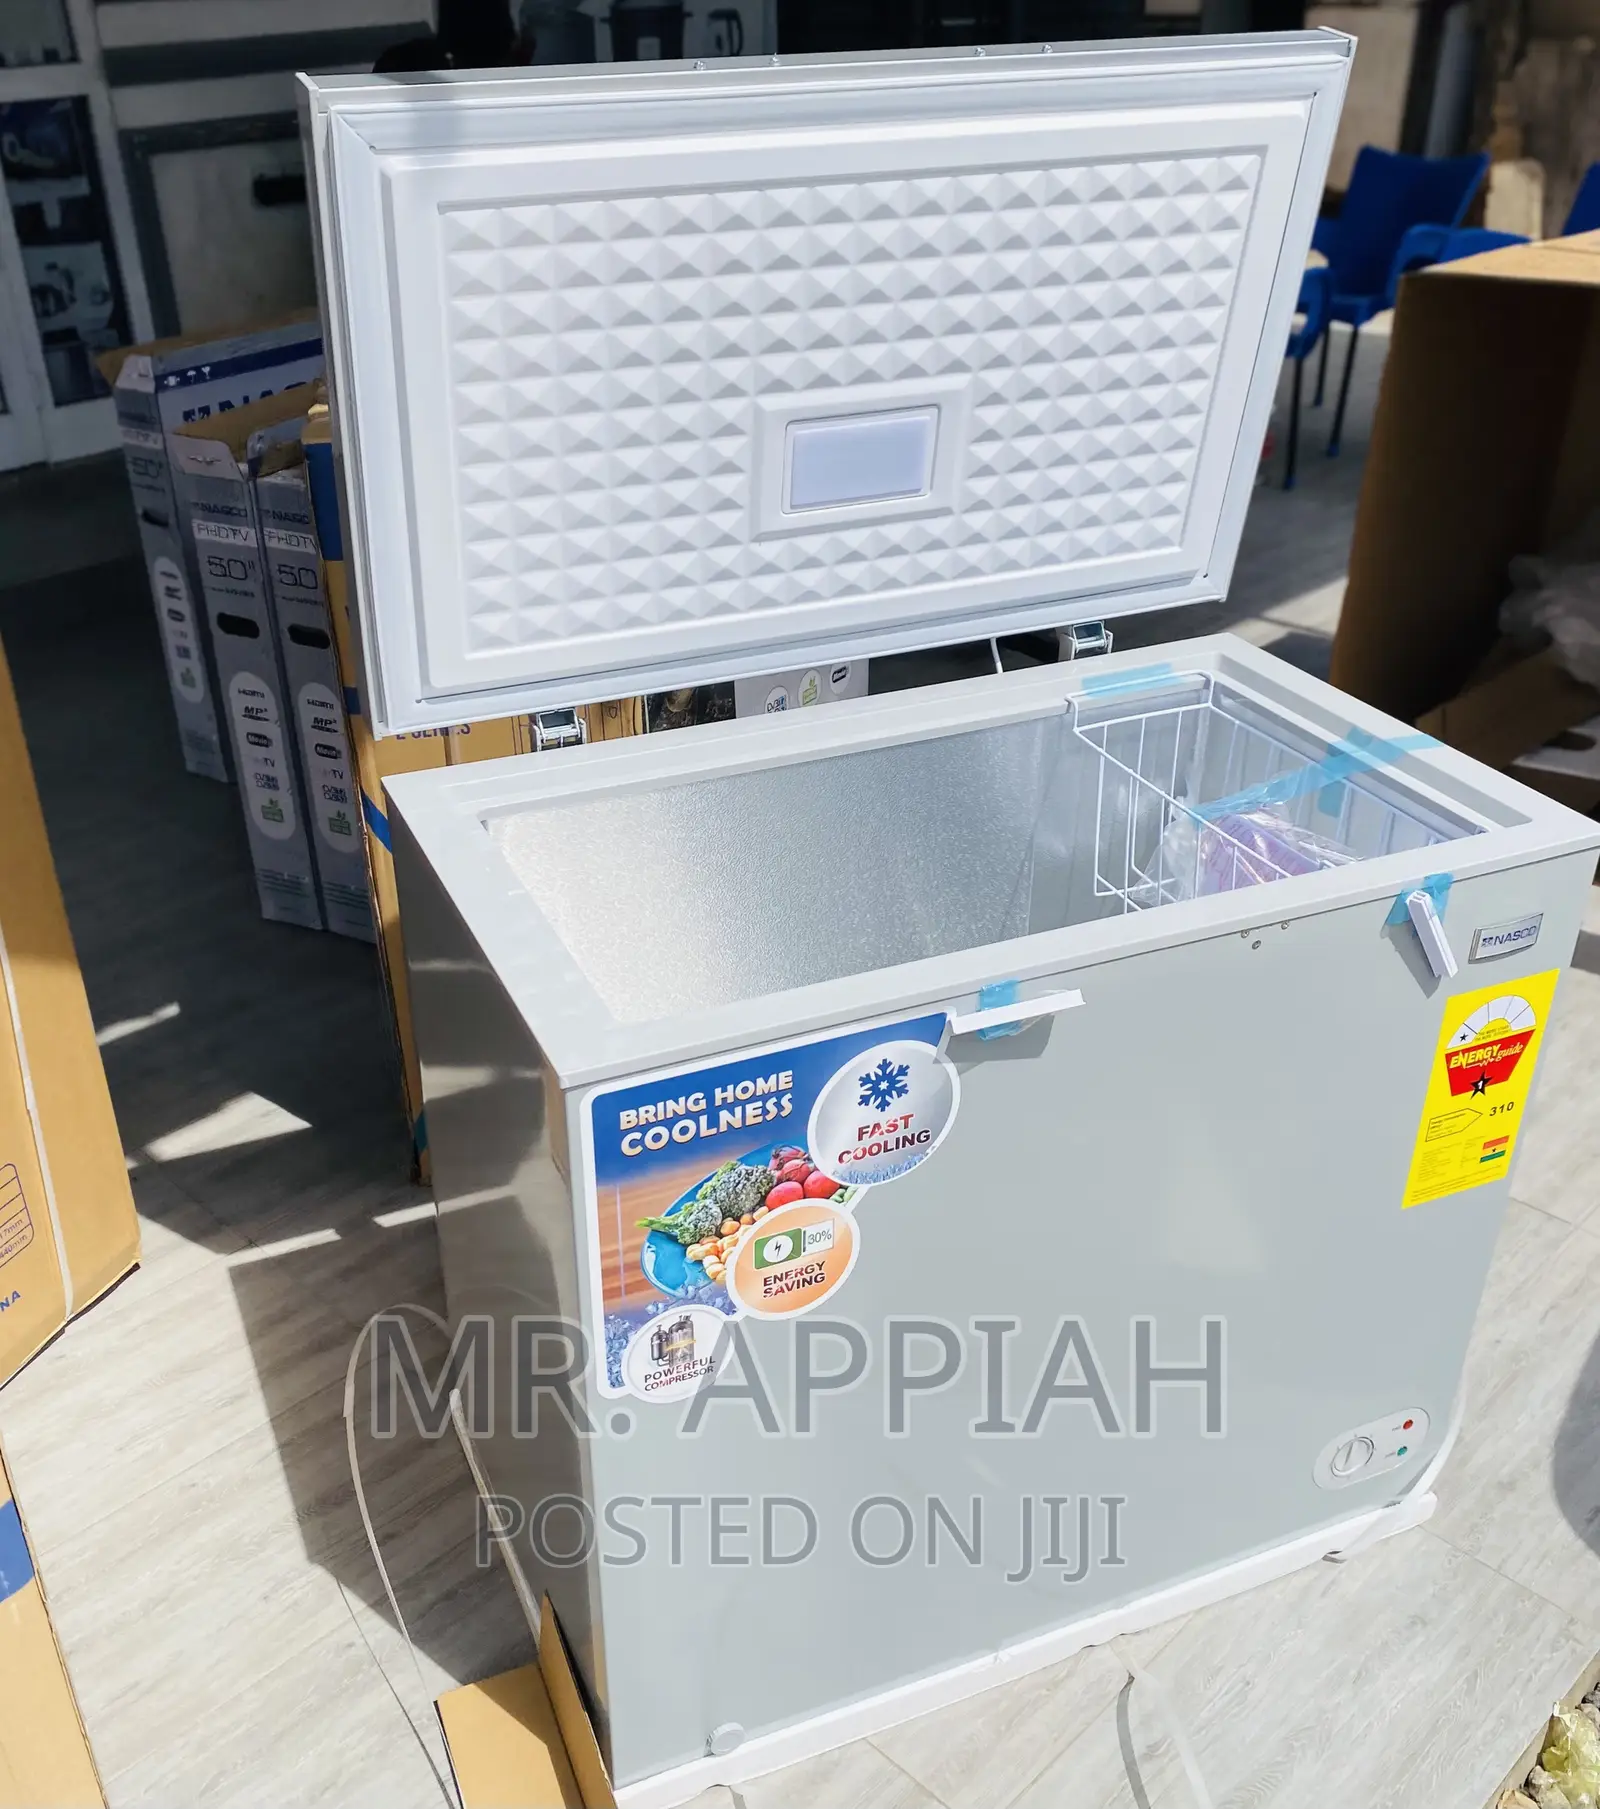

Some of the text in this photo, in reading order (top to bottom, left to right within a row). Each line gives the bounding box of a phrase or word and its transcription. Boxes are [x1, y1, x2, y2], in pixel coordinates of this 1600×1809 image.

[1494, 925, 1537, 946] NASCO
[1449, 1043, 1502, 1069] ENERGY
[619, 1069, 794, 1132] BRING HOME
[1489, 1101, 1515, 1117] 310
[620, 1093, 793, 1157] COOLNESS
[857, 1113, 915, 1142] FAST
[838, 1128, 932, 1166] COOLING
[807, 1228, 833, 1247] 30%
[763, 1260, 827, 1288] ENERGY
[763, 1272, 826, 1300] SAVING
[644, 1355, 716, 1384] POWERFUL
[644, 1365, 715, 1392] COMPRESSOR
